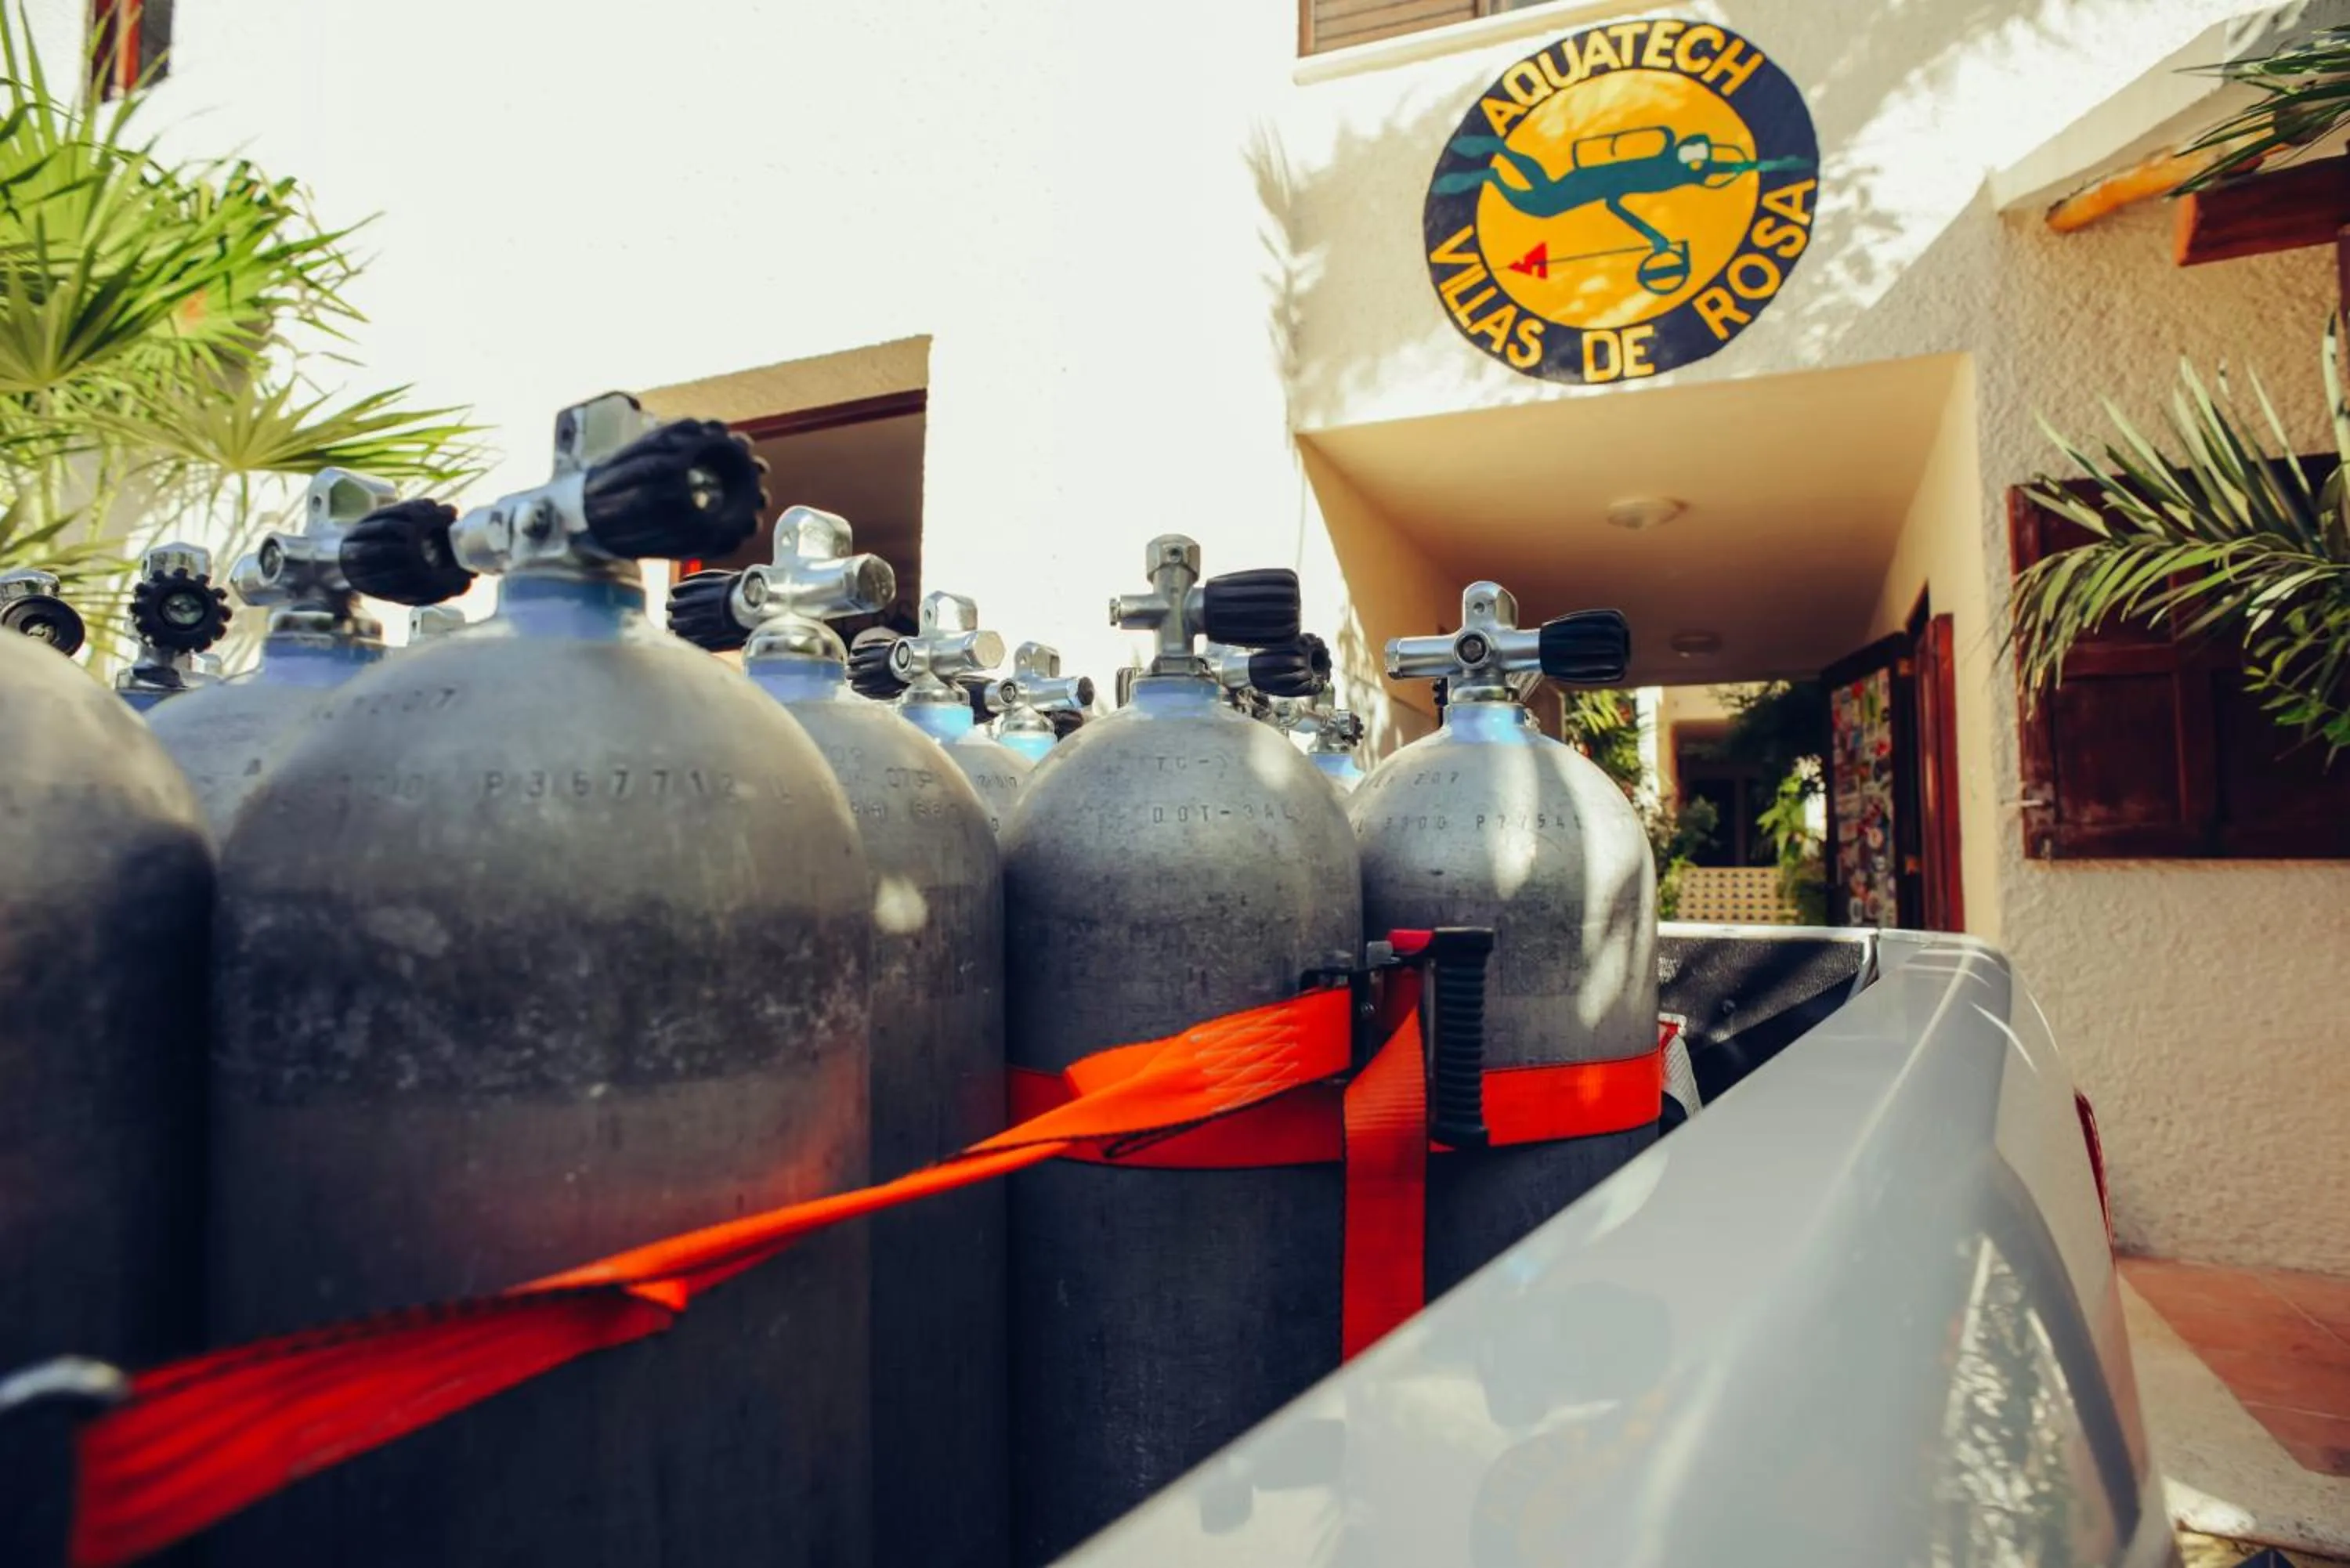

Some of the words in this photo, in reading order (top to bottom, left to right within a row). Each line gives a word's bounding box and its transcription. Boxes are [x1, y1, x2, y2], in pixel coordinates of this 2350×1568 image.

[1480, 20, 1765, 136] AQUATECH
[1430, 225, 1545, 370] VILLAS
[1582, 324, 1655, 384] DE
[1692, 179, 1817, 341] ROSA
